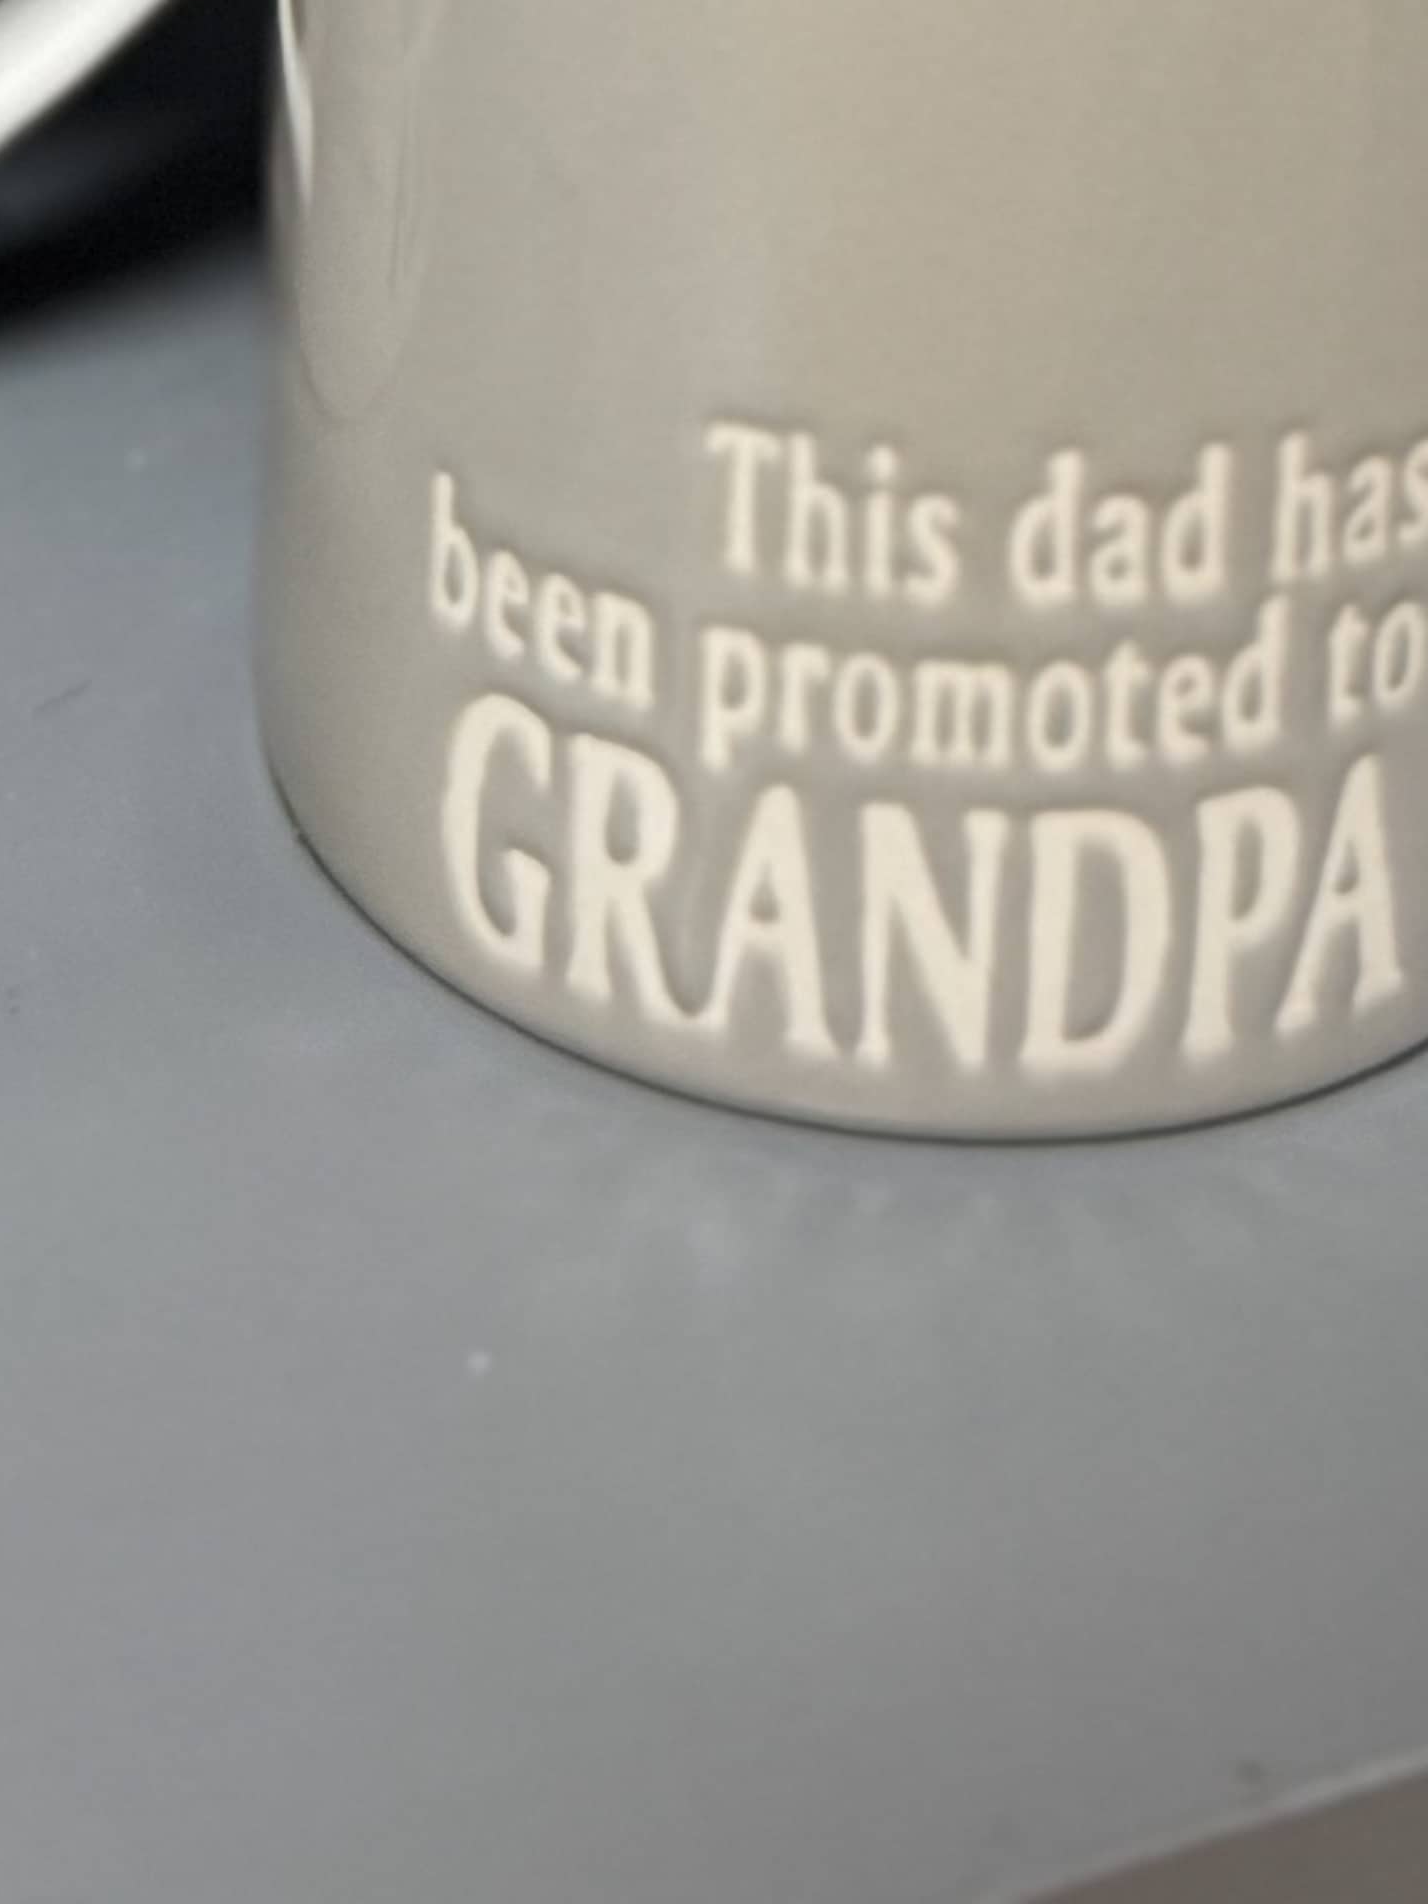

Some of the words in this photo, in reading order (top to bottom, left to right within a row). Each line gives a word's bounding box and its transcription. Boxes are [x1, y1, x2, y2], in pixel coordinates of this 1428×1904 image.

[429, 471, 654, 710] been
[701, 596, 1286, 773] promoted
[1329, 600, 1427, 725] to
[706, 422, 960, 598] This
[1008, 447, 1234, 605] dad
[443, 693, 1404, 1072] GRANDPA
